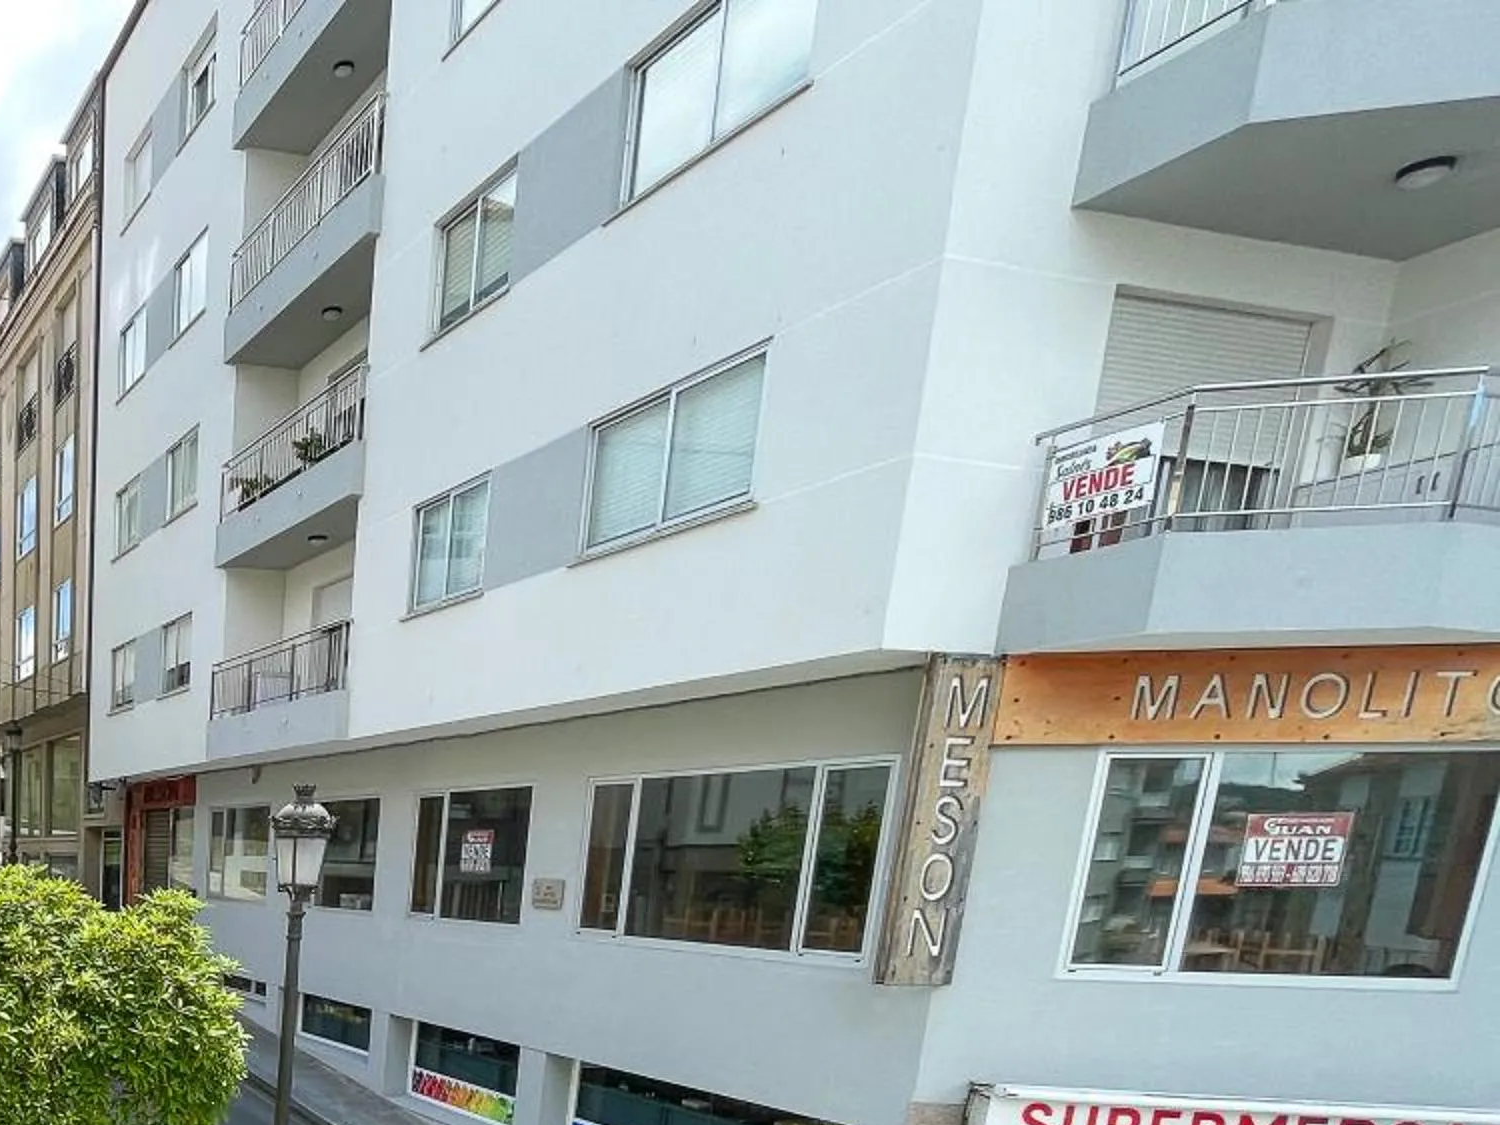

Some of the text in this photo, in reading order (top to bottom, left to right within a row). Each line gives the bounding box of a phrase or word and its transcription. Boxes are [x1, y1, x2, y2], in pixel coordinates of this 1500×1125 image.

[1062, 463, 1136, 501] VENDE
[1078, 499, 1095, 515] 10
[1099, 493, 1119, 509] 48
[1123, 486, 1145, 505] 24
[1130, 670, 1500, 721] MANOLIT
[902, 675, 990, 959] MESON
[1254, 838, 1339, 861] VENDE
